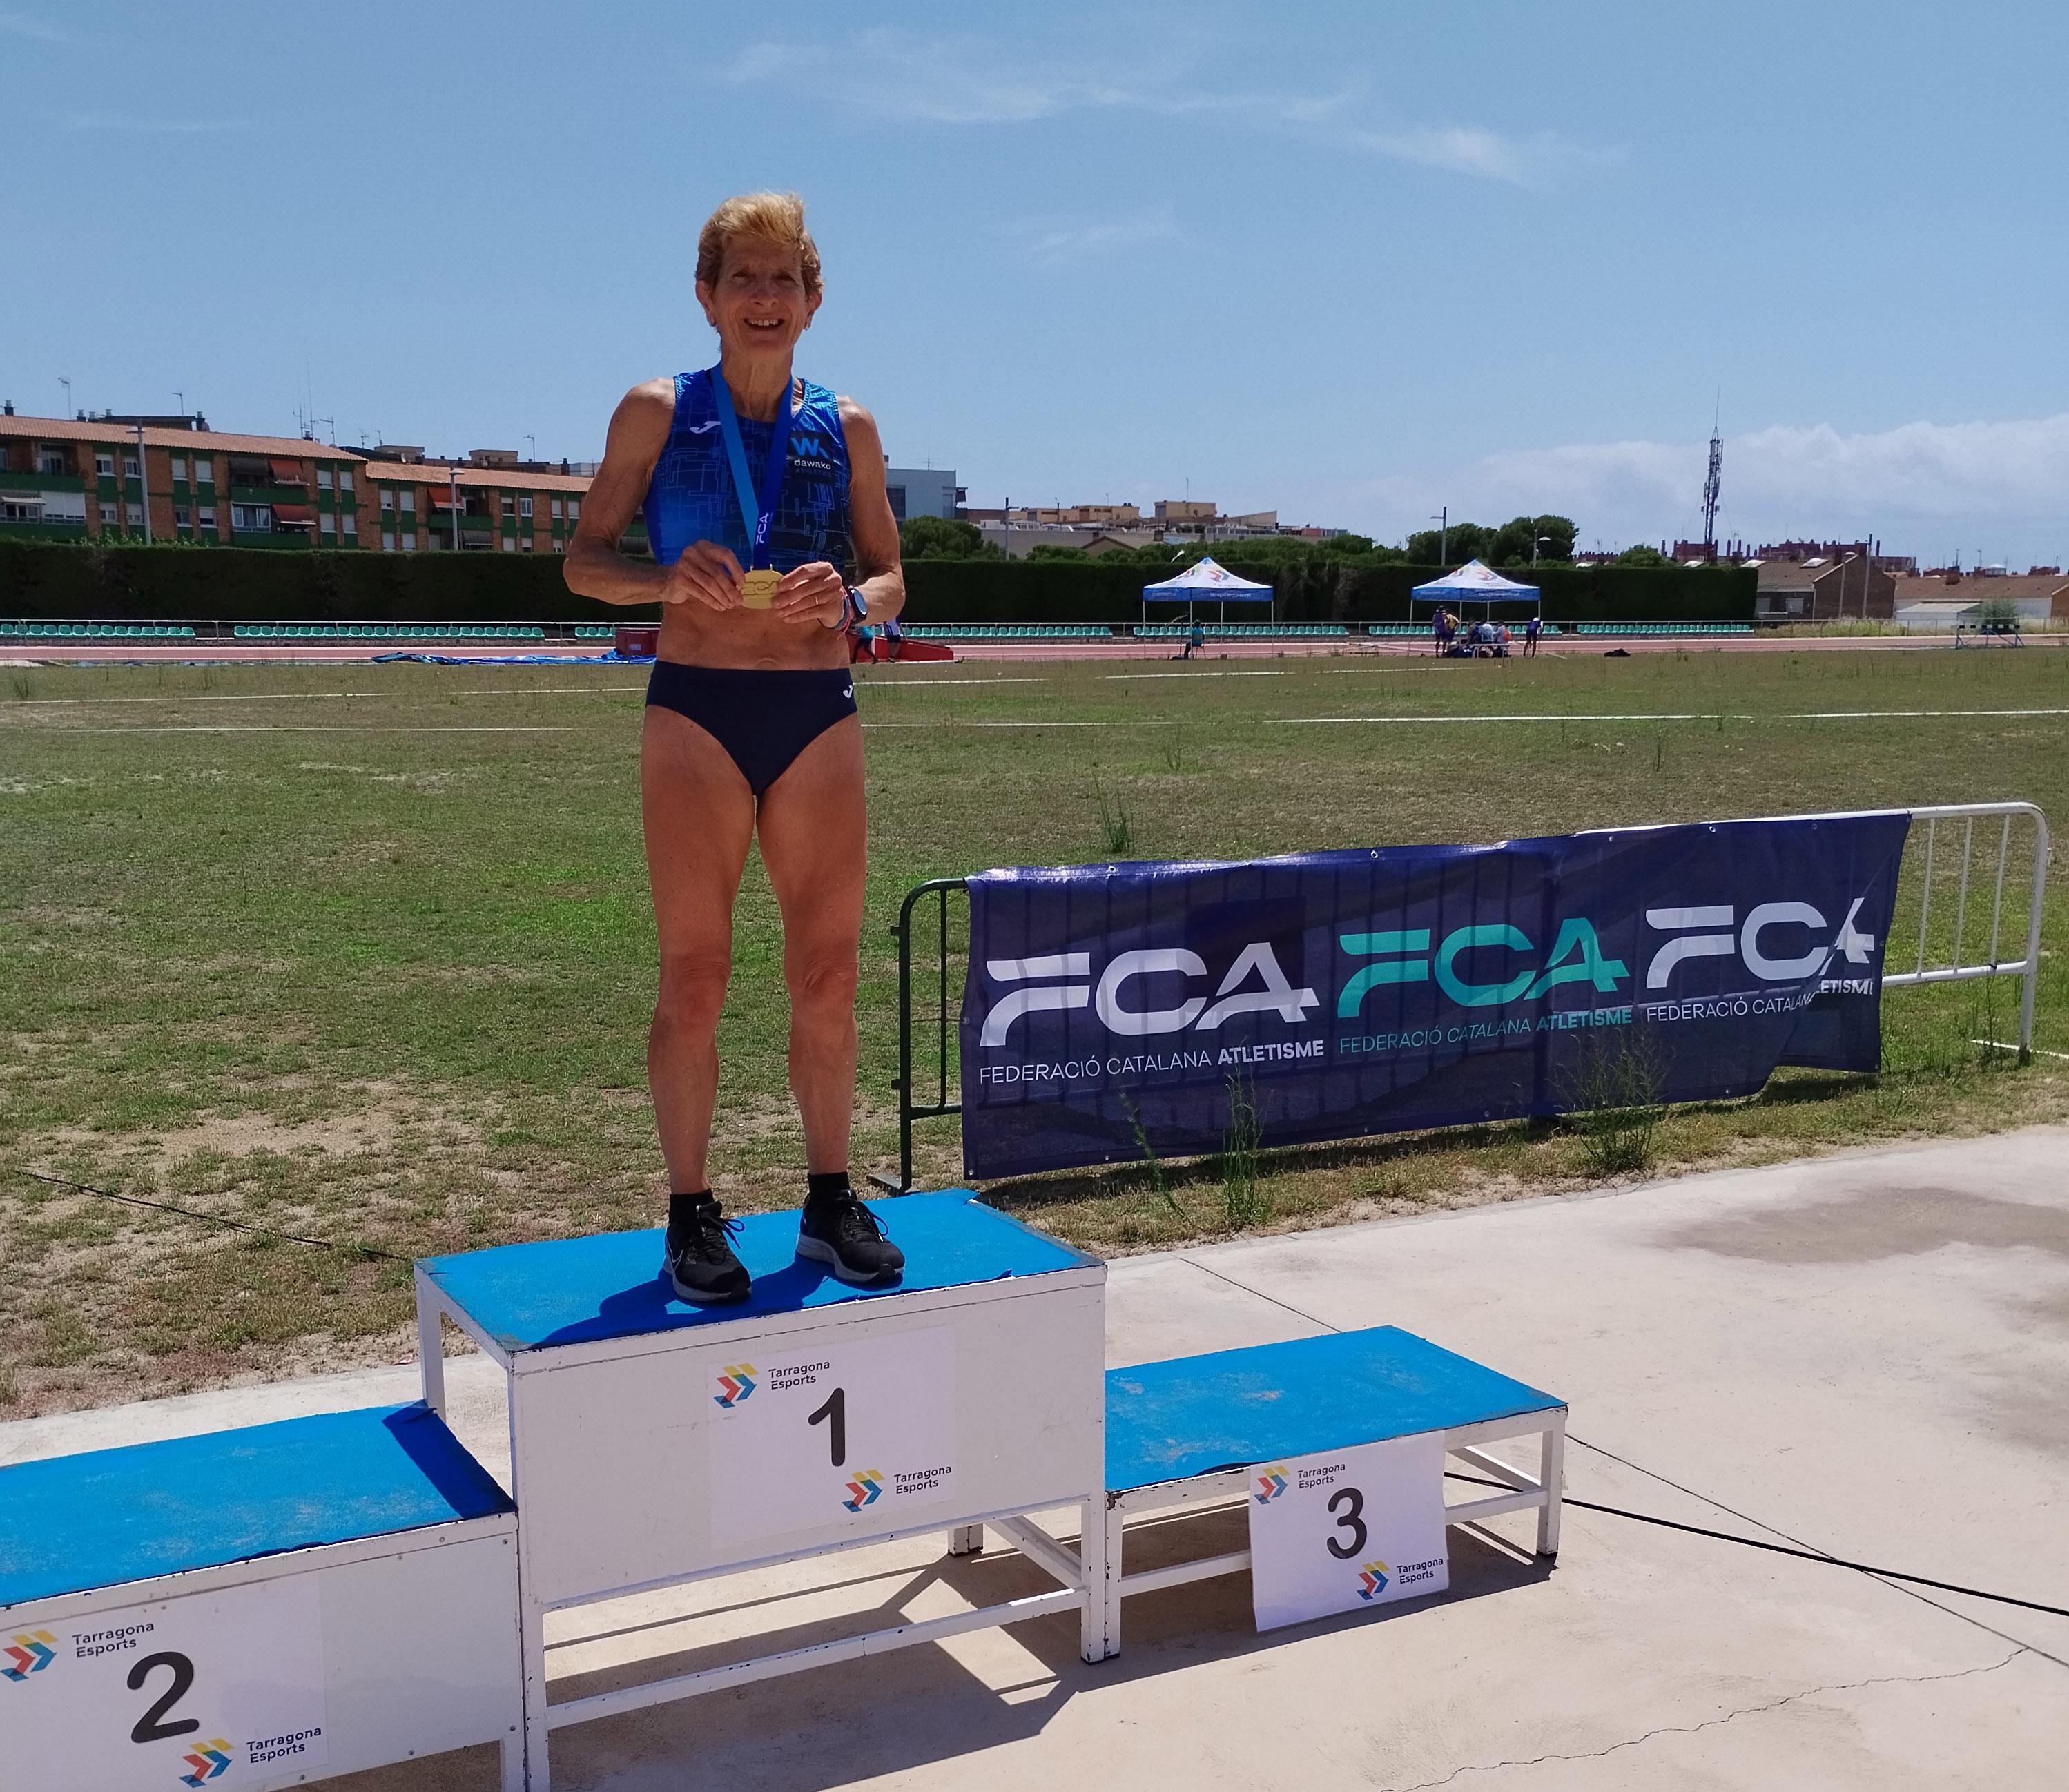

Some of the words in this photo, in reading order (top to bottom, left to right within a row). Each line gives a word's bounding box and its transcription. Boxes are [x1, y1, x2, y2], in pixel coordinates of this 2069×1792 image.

[794, 458, 831, 470] dawako
[1337, 917, 1630, 1018] FCA
[980, 942, 1320, 1047] FCA
[1647, 996, 1748, 1022] FEDERACIÓ
[1339, 1024, 1442, 1054] FEDERACIÓ
[1447, 1019, 1531, 1044] CATALANA
[1536, 1009, 1632, 1031] ATLETISME
[980, 1055, 1100, 1086] FEDERACIÓ
[1107, 1049, 1212, 1075] CATALANA
[1218, 1040, 1324, 1067] ATLETISME
[768, 1360, 830, 1379] Tarragona
[771, 1374, 816, 1390] Esports
[808, 1387, 846, 1467] 1
[893, 1465, 952, 1484] Tarragona
[1298, 1463, 1346, 1479] Tarragona
[1299, 1475, 1334, 1489] Esports
[895, 1479, 939, 1494] Esports
[1326, 1487, 1368, 1559] 3
[1397, 1558, 1444, 1575] Tarragona
[1399, 1570, 1435, 1584] Esports
[72, 1621, 155, 1646] Tarragona
[76, 1638, 137, 1659] Esports
[126, 1650, 200, 1744] 2
[246, 1726, 322, 1753] Tarragona
[249, 1742, 306, 1764] Esports
